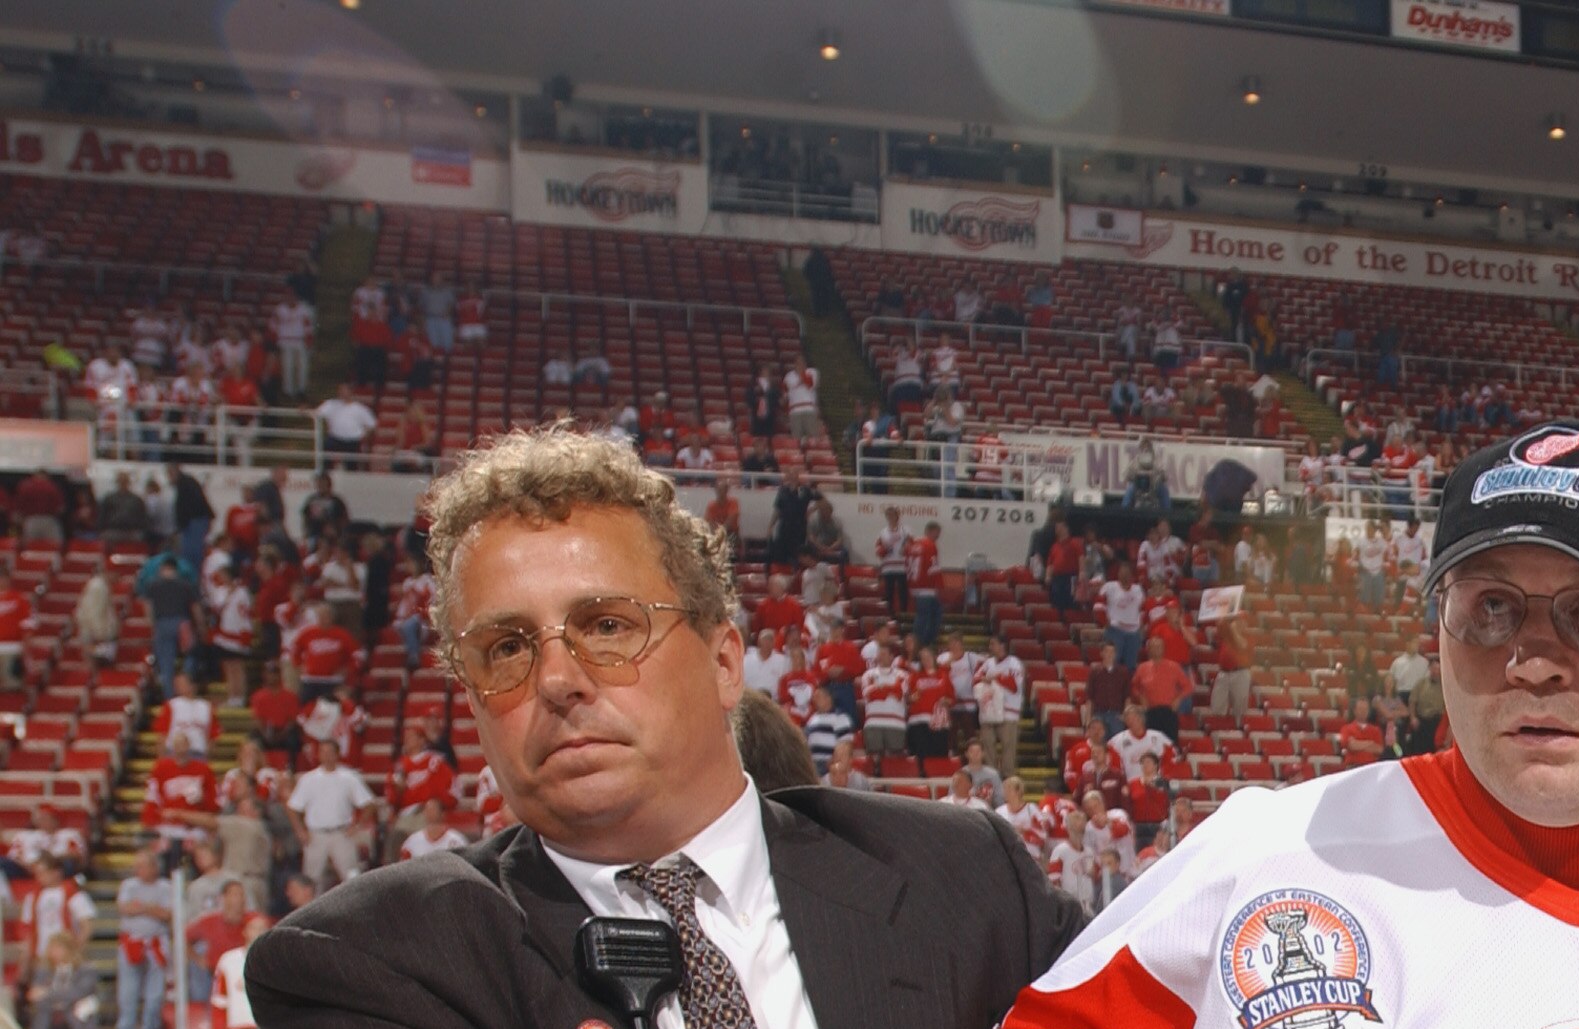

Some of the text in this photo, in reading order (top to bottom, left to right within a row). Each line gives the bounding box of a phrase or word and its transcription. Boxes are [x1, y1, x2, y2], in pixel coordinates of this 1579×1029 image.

[1408, 5, 1514, 38] Dunham's
[68, 128, 235, 180] Arena
[546, 178, 678, 218] HOCKEYTOWN
[909, 208, 1037, 248] HOCKEYTOWN
[1189, 229, 1285, 261] Home
[1303, 242, 1339, 265] of
[1355, 244, 1407, 272] the
[1425, 251, 1538, 285] Detroit
[1480, 467, 1577, 496] Stanley
[951, 505, 990, 522] 207
[996, 508, 1035, 524] 208
[619, 929, 660, 937] MOTOROLA
[1224, 892, 1274, 952] CONFERENCE
[1290, 890, 1340, 915] EASTERN
[1338, 909, 1370, 981] CONFERENCE
[1249, 979, 1362, 1025] STANLEY CUP
